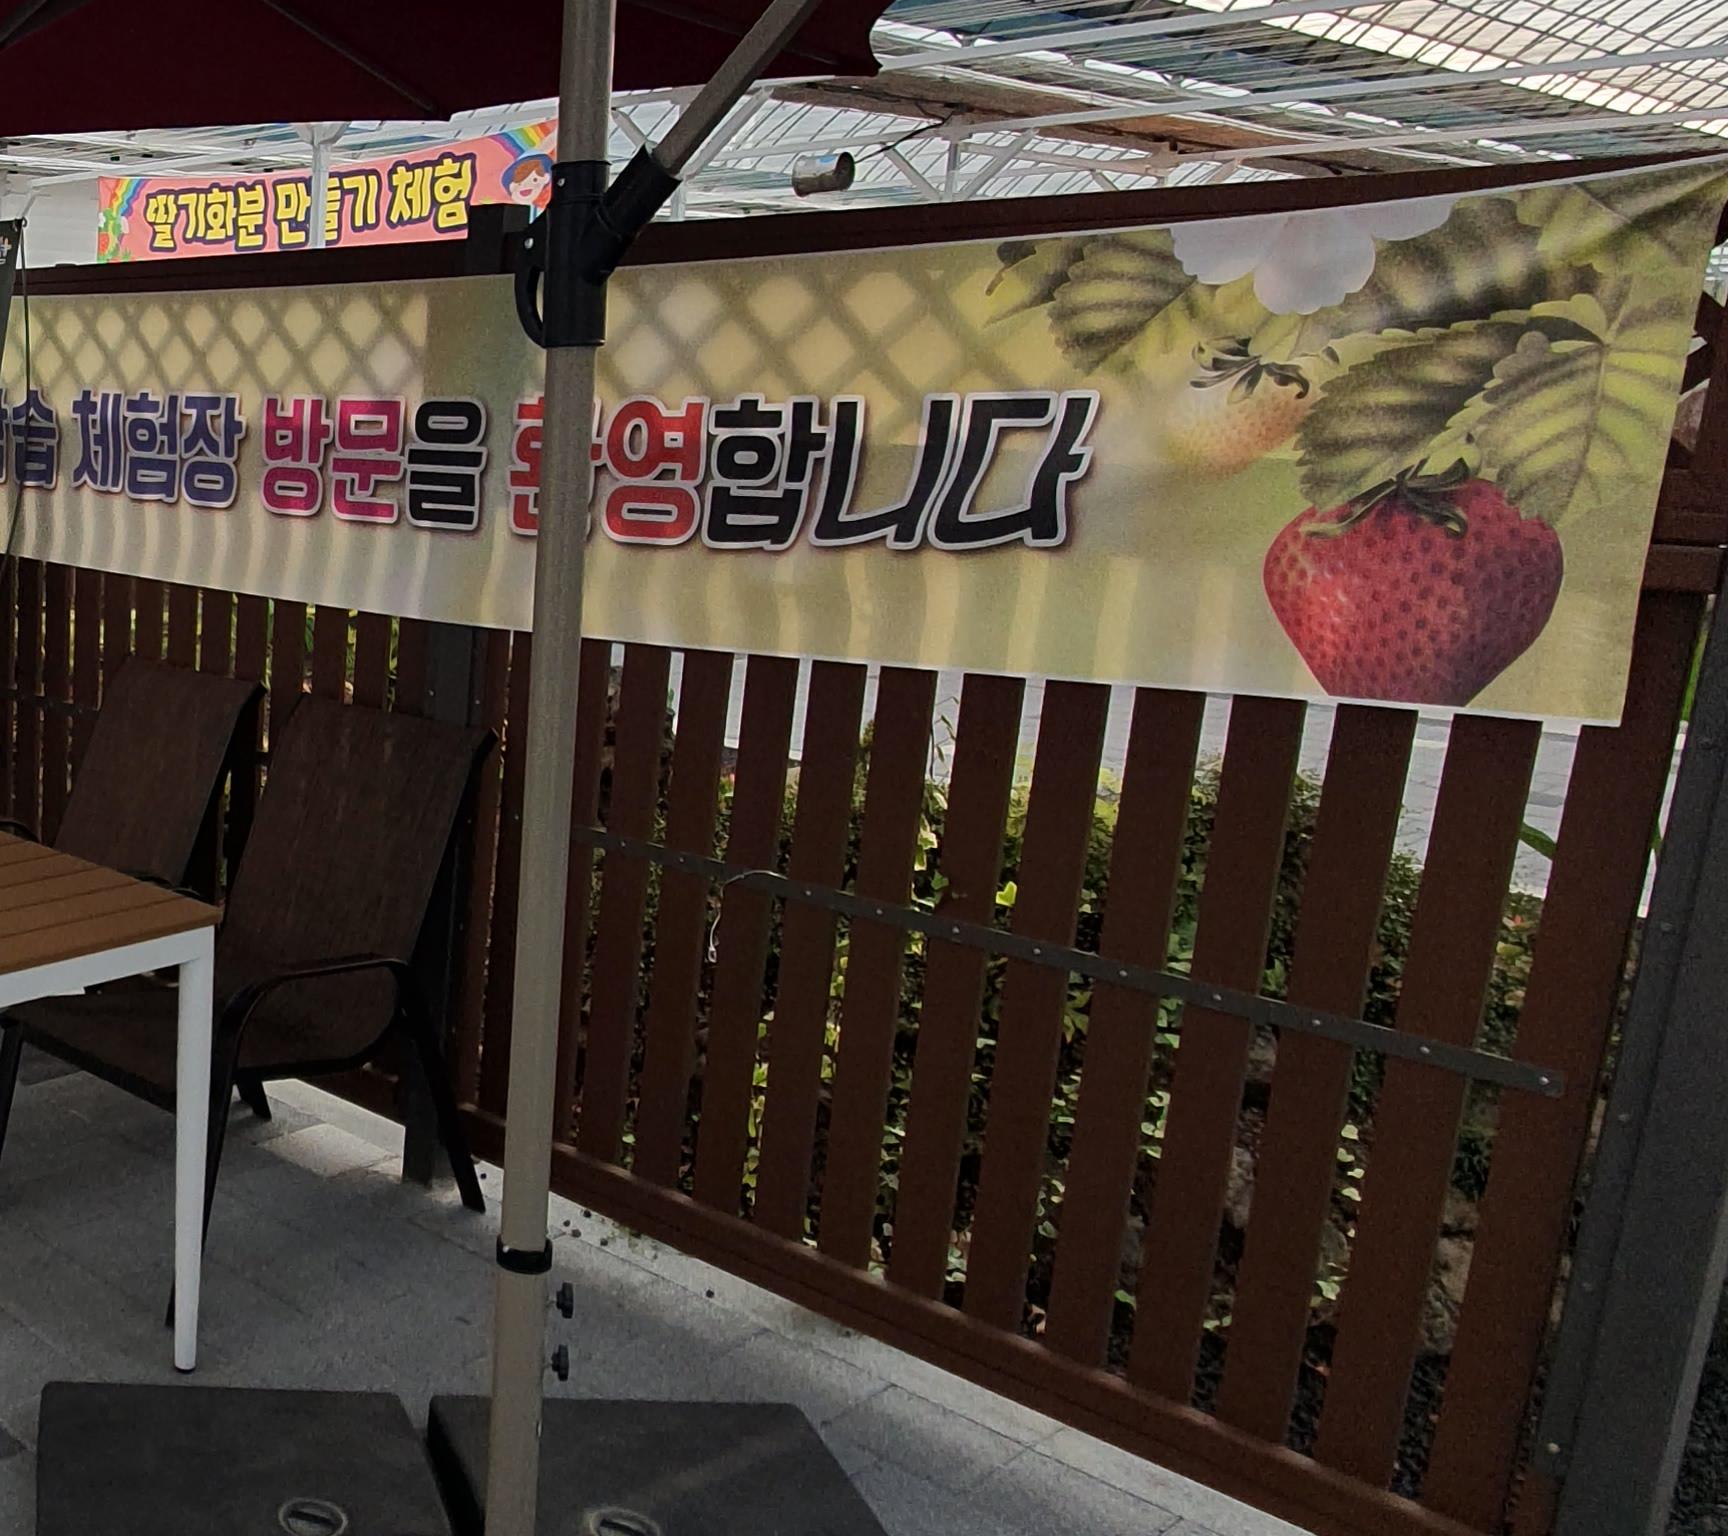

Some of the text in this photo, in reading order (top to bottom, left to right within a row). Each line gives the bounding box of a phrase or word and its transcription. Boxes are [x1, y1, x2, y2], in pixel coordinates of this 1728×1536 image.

[145, 182, 266, 250] 딸기화분
[389, 157, 472, 229] 체험
[71, 388, 247, 508] 체험장
[261, 394, 488, 531] 방문을
